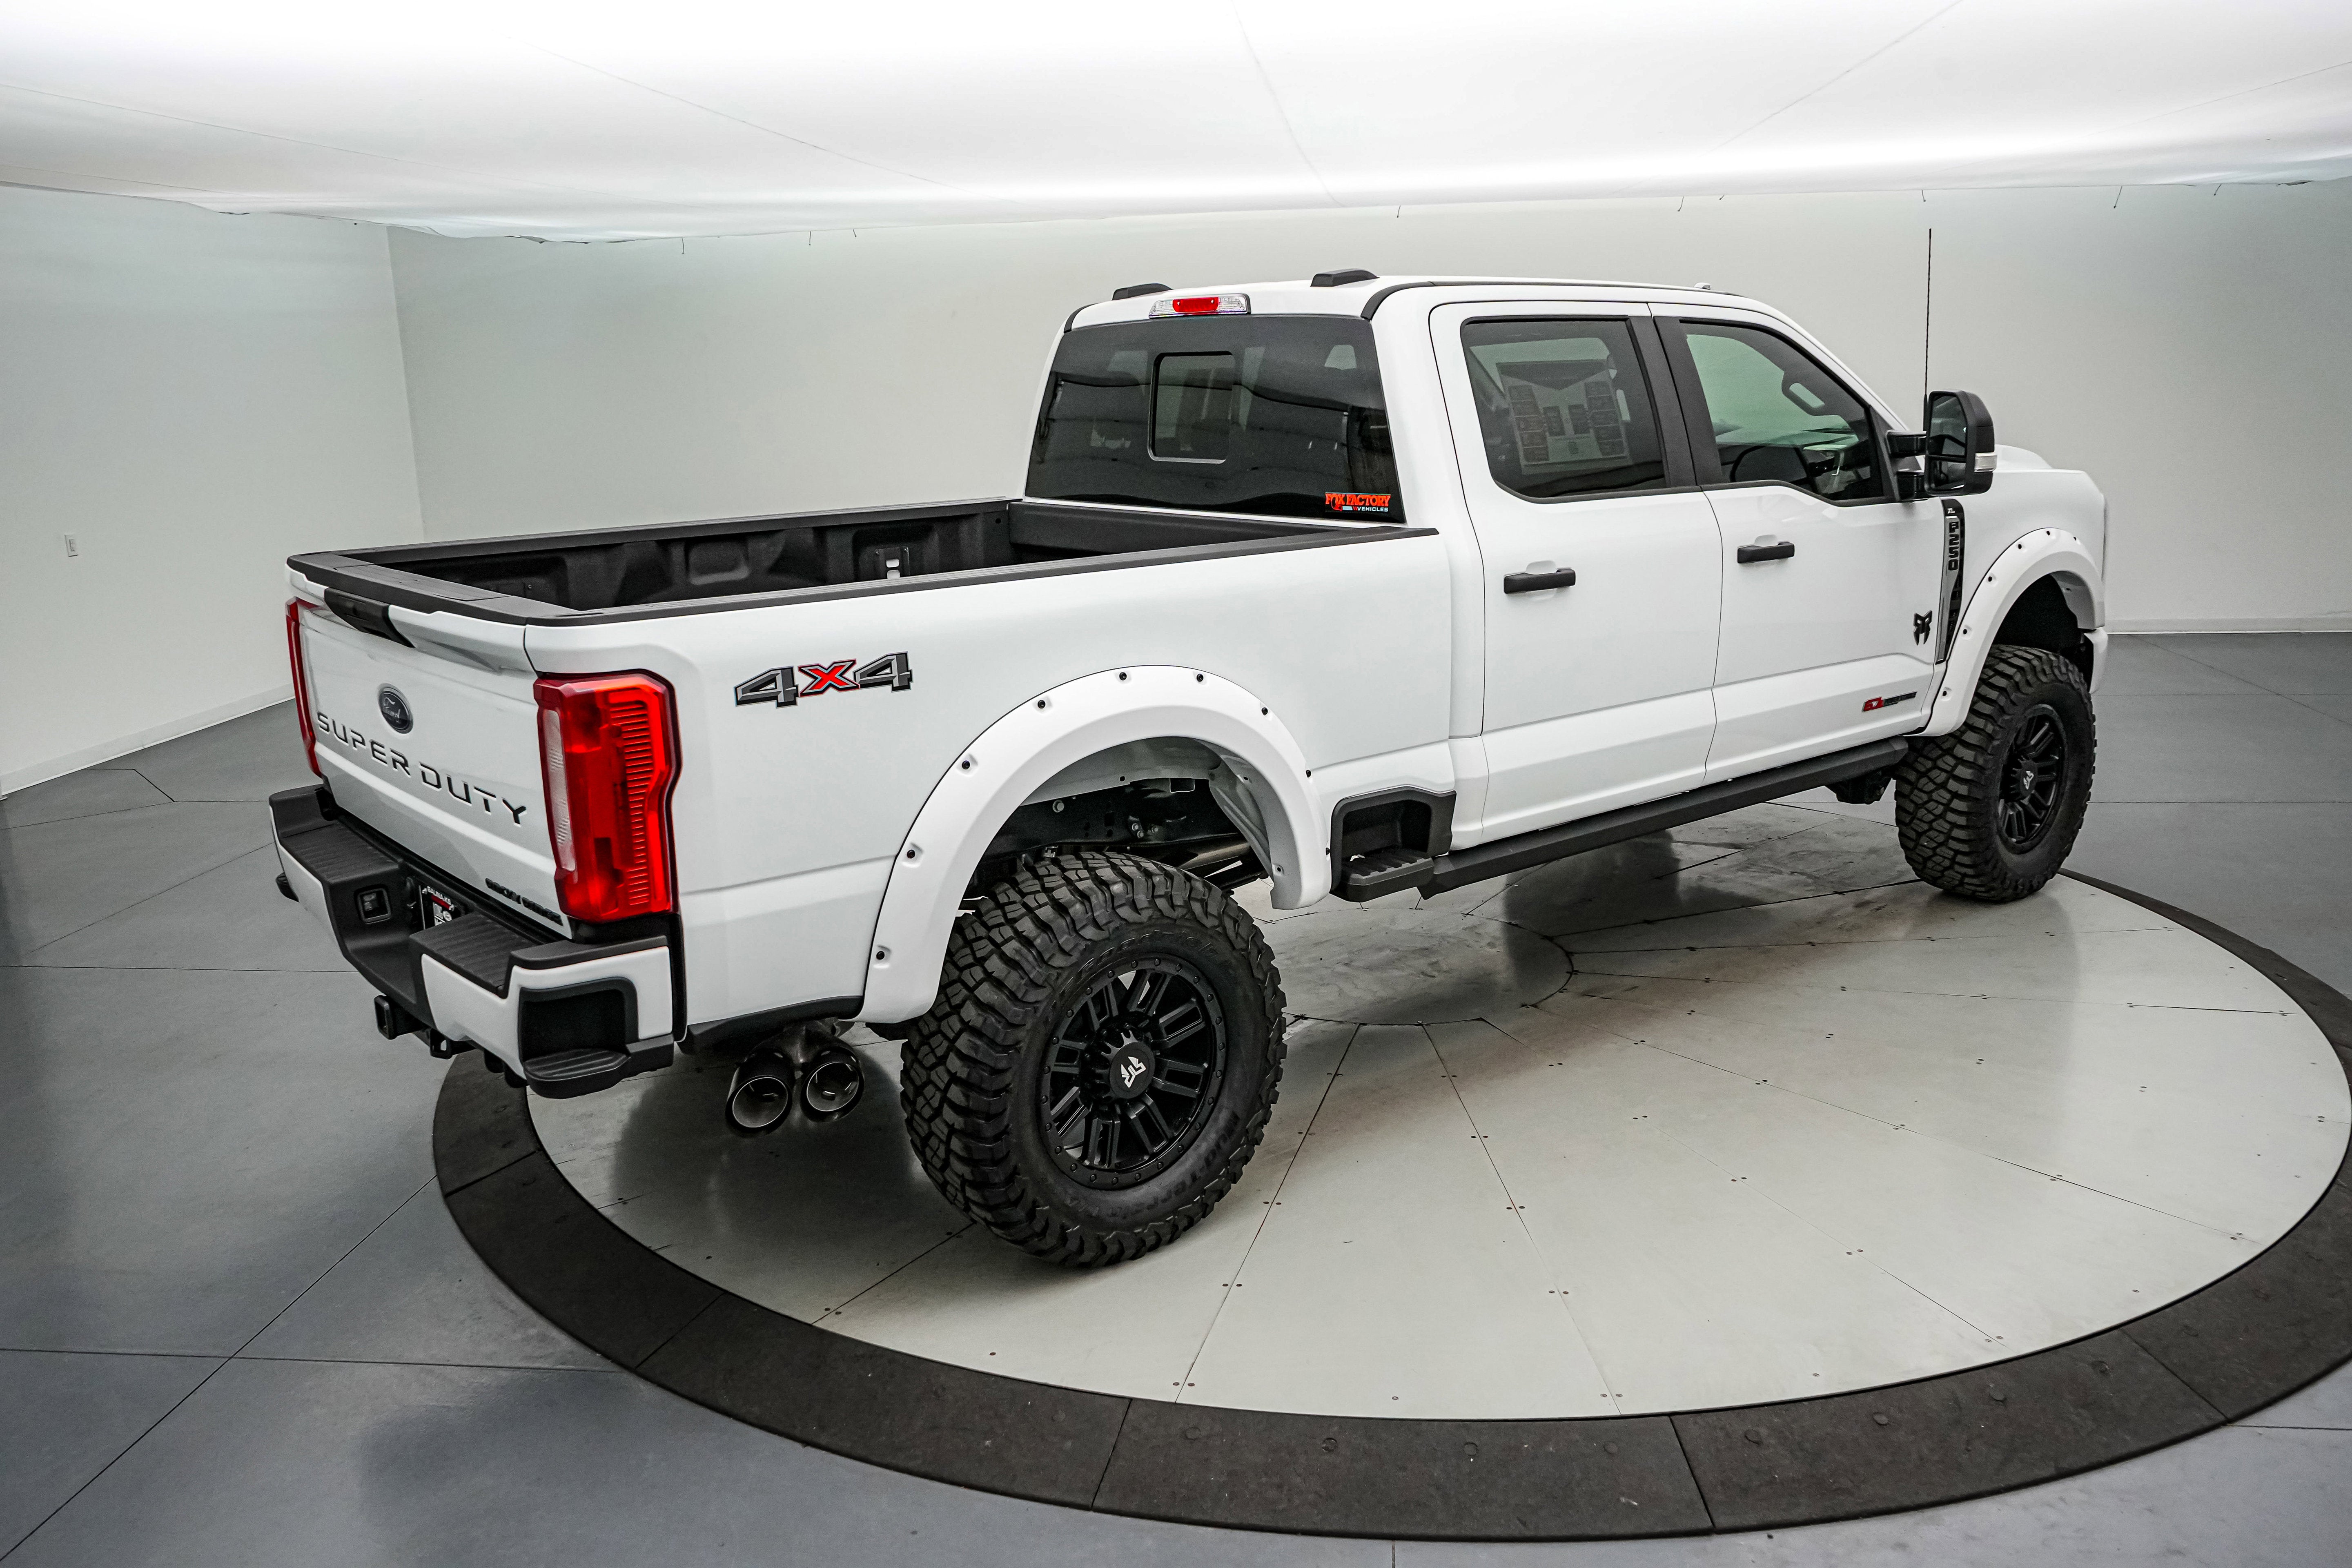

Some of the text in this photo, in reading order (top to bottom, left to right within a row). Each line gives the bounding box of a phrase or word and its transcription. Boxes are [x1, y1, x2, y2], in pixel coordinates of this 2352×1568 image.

[1325, 493, 1391, 510] FOX FACTORY
[1948, 521, 1960, 570] F250
[733, 651, 913, 708] 4X4
[317, 712, 527, 827] SUPER DUTY
